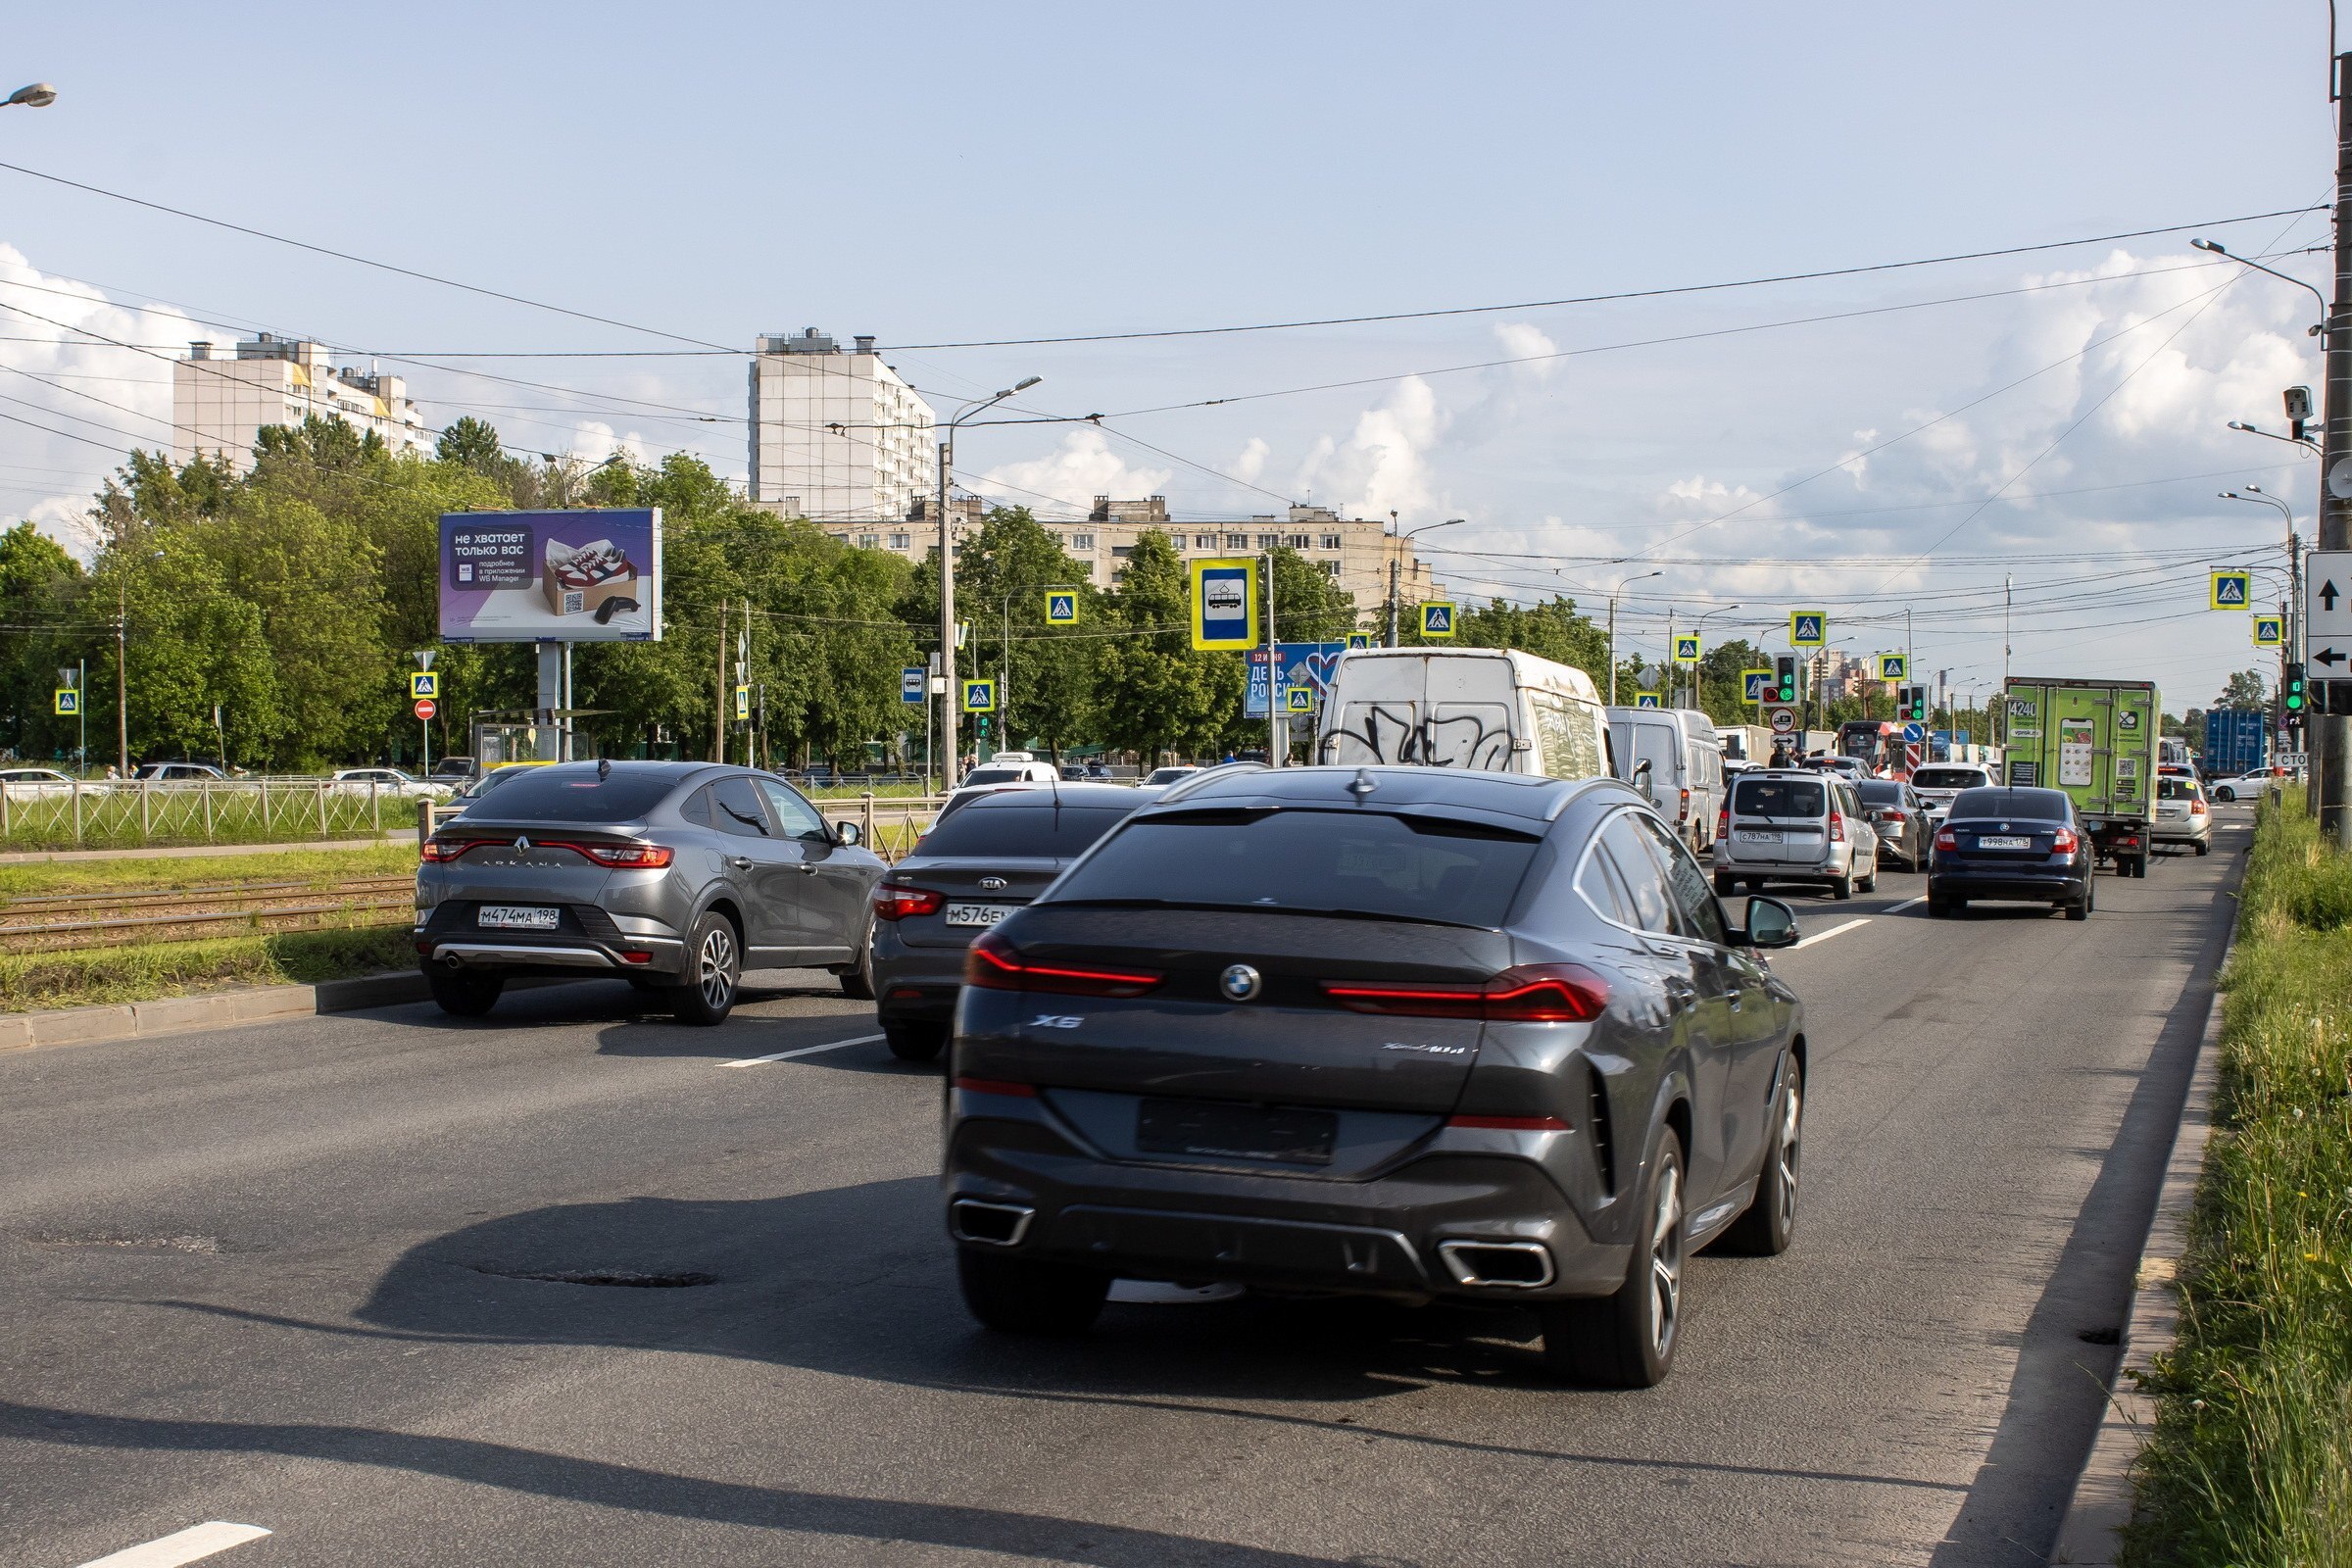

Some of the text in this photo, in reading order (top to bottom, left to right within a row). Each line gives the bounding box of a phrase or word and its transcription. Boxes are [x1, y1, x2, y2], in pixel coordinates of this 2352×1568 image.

[455, 533, 525, 544] не хватает
[455, 545, 524, 556] только вас
[1250, 683, 1299, 698] РОСИ
[2010, 702, 2036, 715] 4240
[2281, 755, 2306, 765] СТО
[482, 860, 563, 869] ARKANA
[982, 880, 1002, 889] KIA
[482, 908, 556, 923] М474МА 198
[1026, 1014, 1085, 1028] X6
